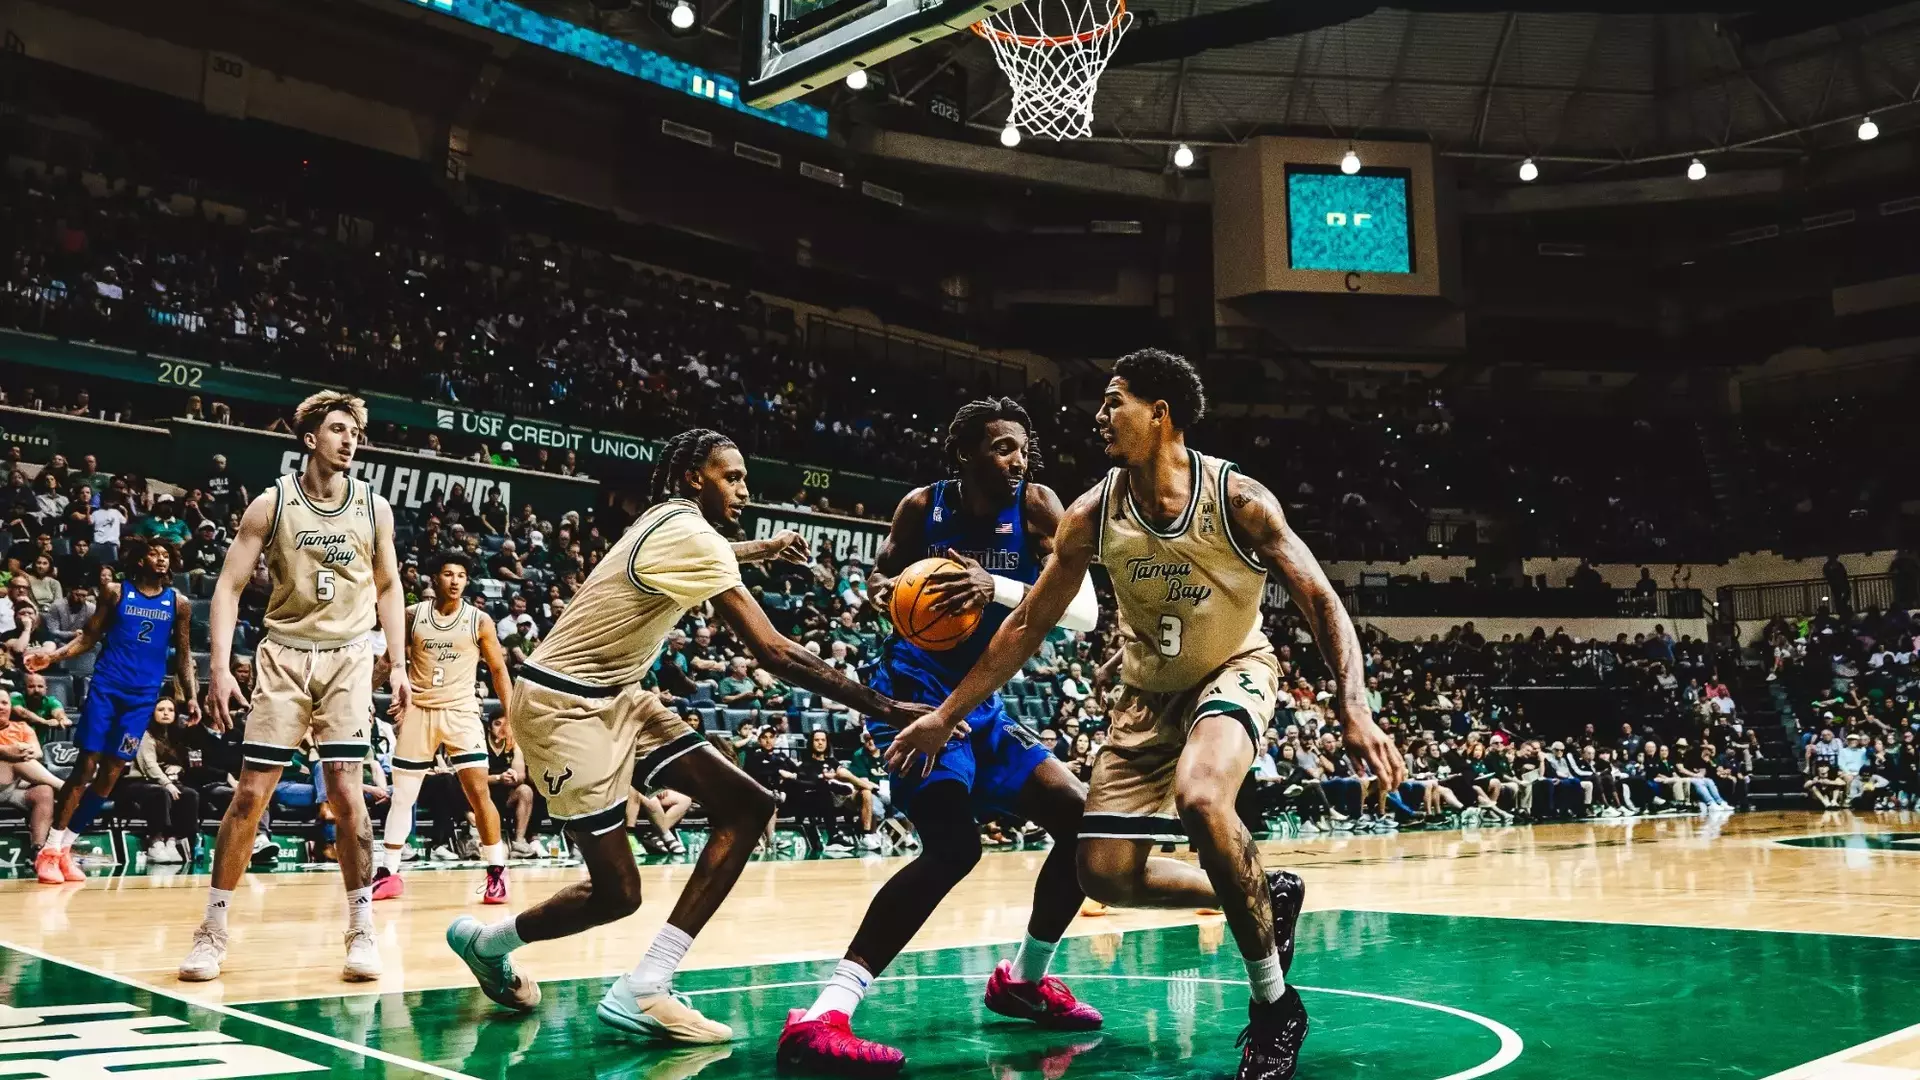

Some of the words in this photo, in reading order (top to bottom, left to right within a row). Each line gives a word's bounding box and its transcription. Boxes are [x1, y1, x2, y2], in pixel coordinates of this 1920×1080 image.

[931, 100, 960, 122] 2025
[1345, 272, 1361, 292] C
[158, 362, 203, 388] 202
[462, 412, 503, 437] USF
[508, 424, 583, 450] CREDIT
[591, 437, 653, 462] UNION
[803, 470, 830, 489] 203
[295, 529, 347, 551] Tampa
[321, 545, 356, 566] Bay
[1126, 553, 1191, 583] Tampa
[316, 570, 336, 601] 5
[1165, 577, 1212, 606] Bay
[124, 604, 172, 620] Memphis
[137, 619, 155, 643] 2
[1159, 614, 1182, 657] 3
[421, 638, 454, 652] Tampa
[437, 649, 462, 662] Bay
[432, 666, 446, 687] 2
